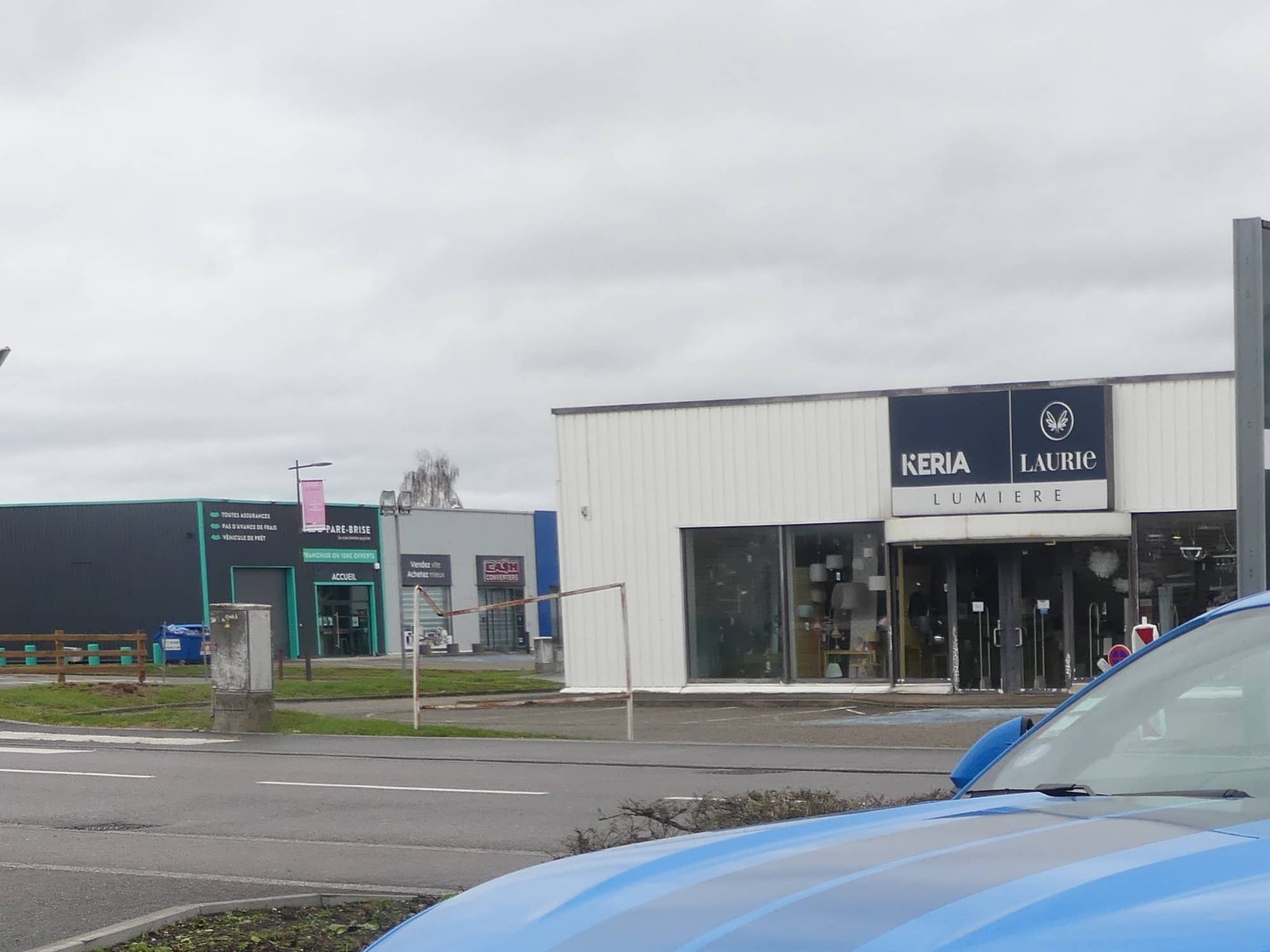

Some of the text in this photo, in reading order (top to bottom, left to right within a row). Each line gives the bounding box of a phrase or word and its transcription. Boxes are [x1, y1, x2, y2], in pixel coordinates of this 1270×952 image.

[902, 451, 971, 476] KERIA
[934, 489, 1062, 505] LUMIERE
[221, 511, 240, 519] TOUTES
[326, 525, 371, 534] PARE-BRISE
[410, 561, 441, 569] Vendez vite
[331, 573, 357, 581] ACCUEIL
[407, 570, 429, 578] Achetez
